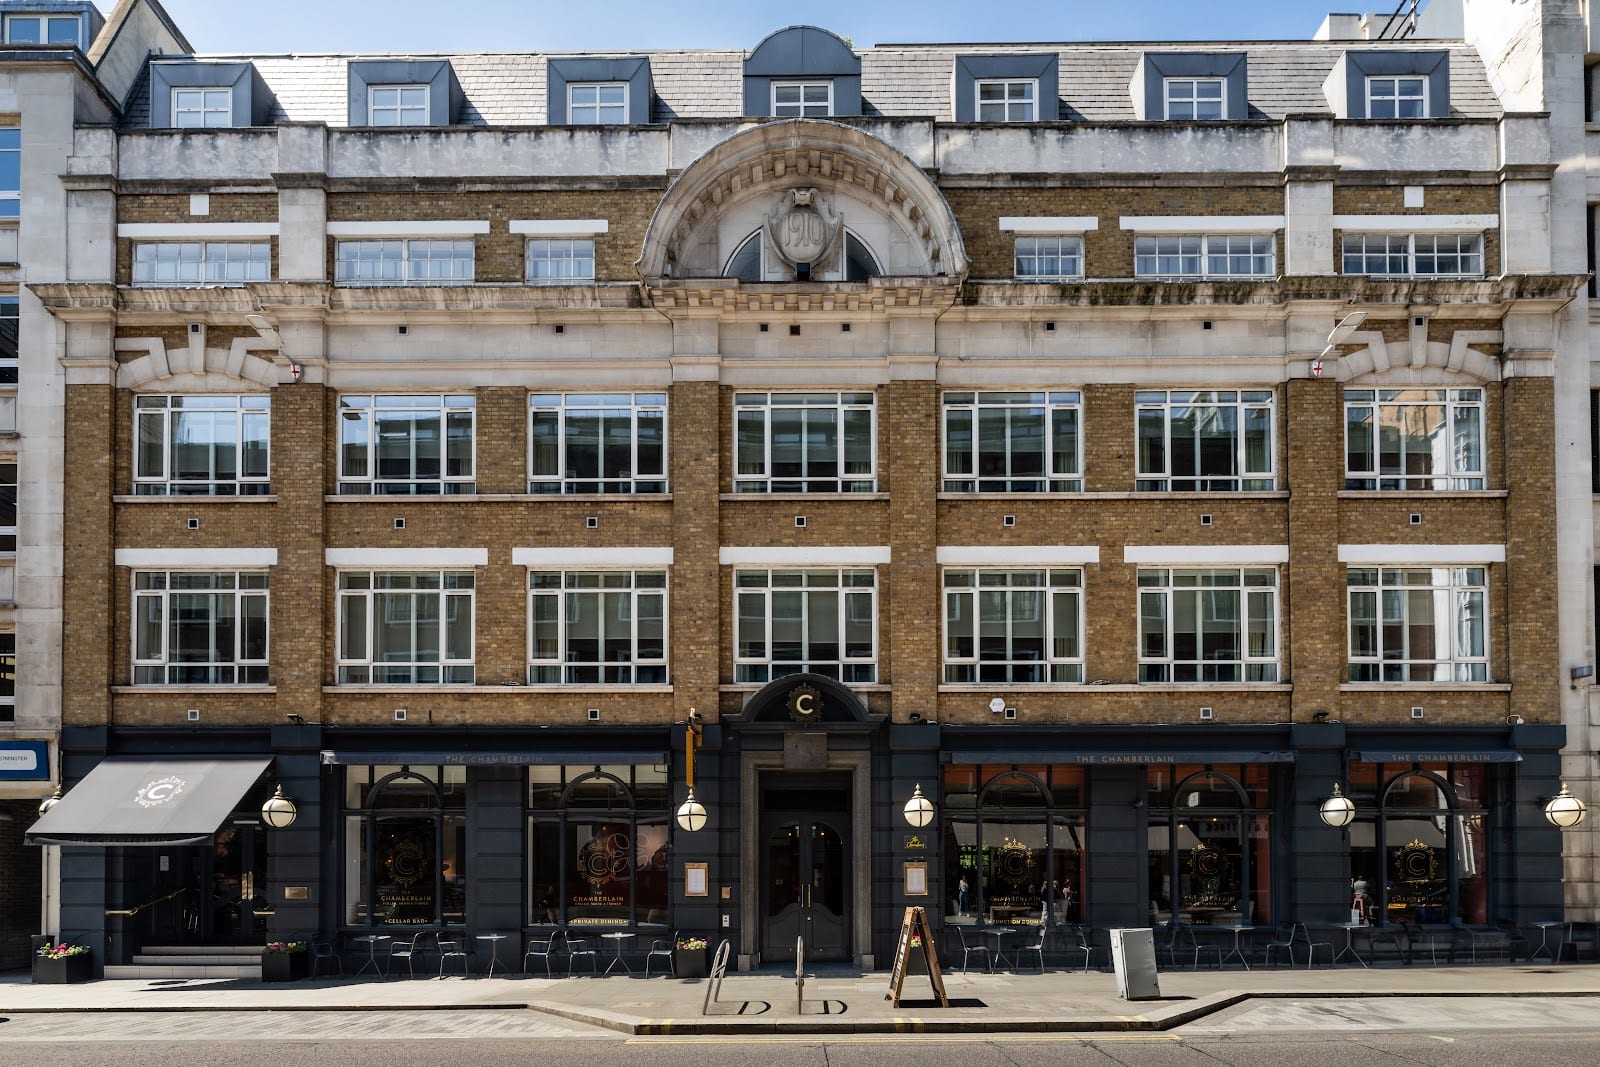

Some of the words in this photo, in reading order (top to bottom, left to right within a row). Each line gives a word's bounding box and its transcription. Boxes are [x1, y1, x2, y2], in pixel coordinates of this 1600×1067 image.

[782, 212, 824, 247] 1910
[796, 694, 813, 715] C
[446, 755, 465, 763] THE
[471, 755, 543, 763] CHAMBERLAIN
[1075, 755, 1096, 763] THE
[1101, 755, 1175, 763] CHAMBERLAIN
[1392, 754, 1411, 762] THE
[1417, 754, 1491, 762] CHAMBERLAIN
